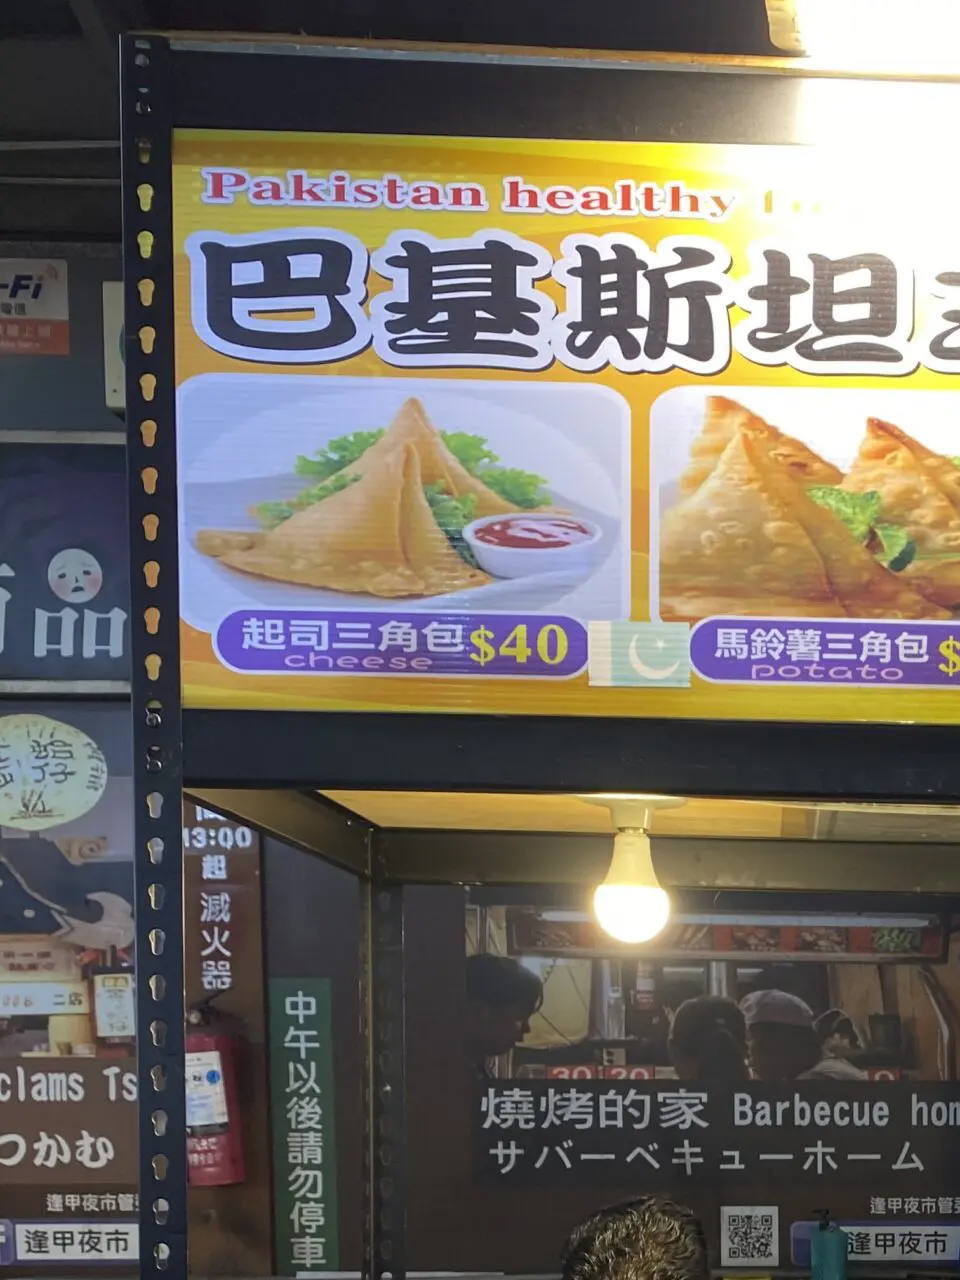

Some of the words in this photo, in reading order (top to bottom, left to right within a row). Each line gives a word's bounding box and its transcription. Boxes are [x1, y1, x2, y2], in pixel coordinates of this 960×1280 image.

[207, 171, 483, 206] Pakistan
[506, 176, 736, 219] healthy
[241, 618, 465, 653] 起司三角包
[470, 623, 569, 667] $40
[284, 650, 433, 671] cheese
[714, 627, 930, 663] 馬鈴薯三角包
[751, 663, 904, 681] potato
[200, 891, 233, 991] 滅火器
[0, 1066, 85, 1102] clams
[480, 1087, 711, 1131] 燒烤的家
[733, 1093, 890, 1128] Barbecue
[283, 990, 328, 1268] 中午以後請勿停車
[0, 1130, 115, 1169] つかむ
[489, 1139, 925, 1176] サバーベキューホーム
[46, 1193, 138, 1212] 逢甲夜市管
[24, 1229, 130, 1255] 逢甲夜市
[848, 1231, 949, 1256] 逢甲夜市
